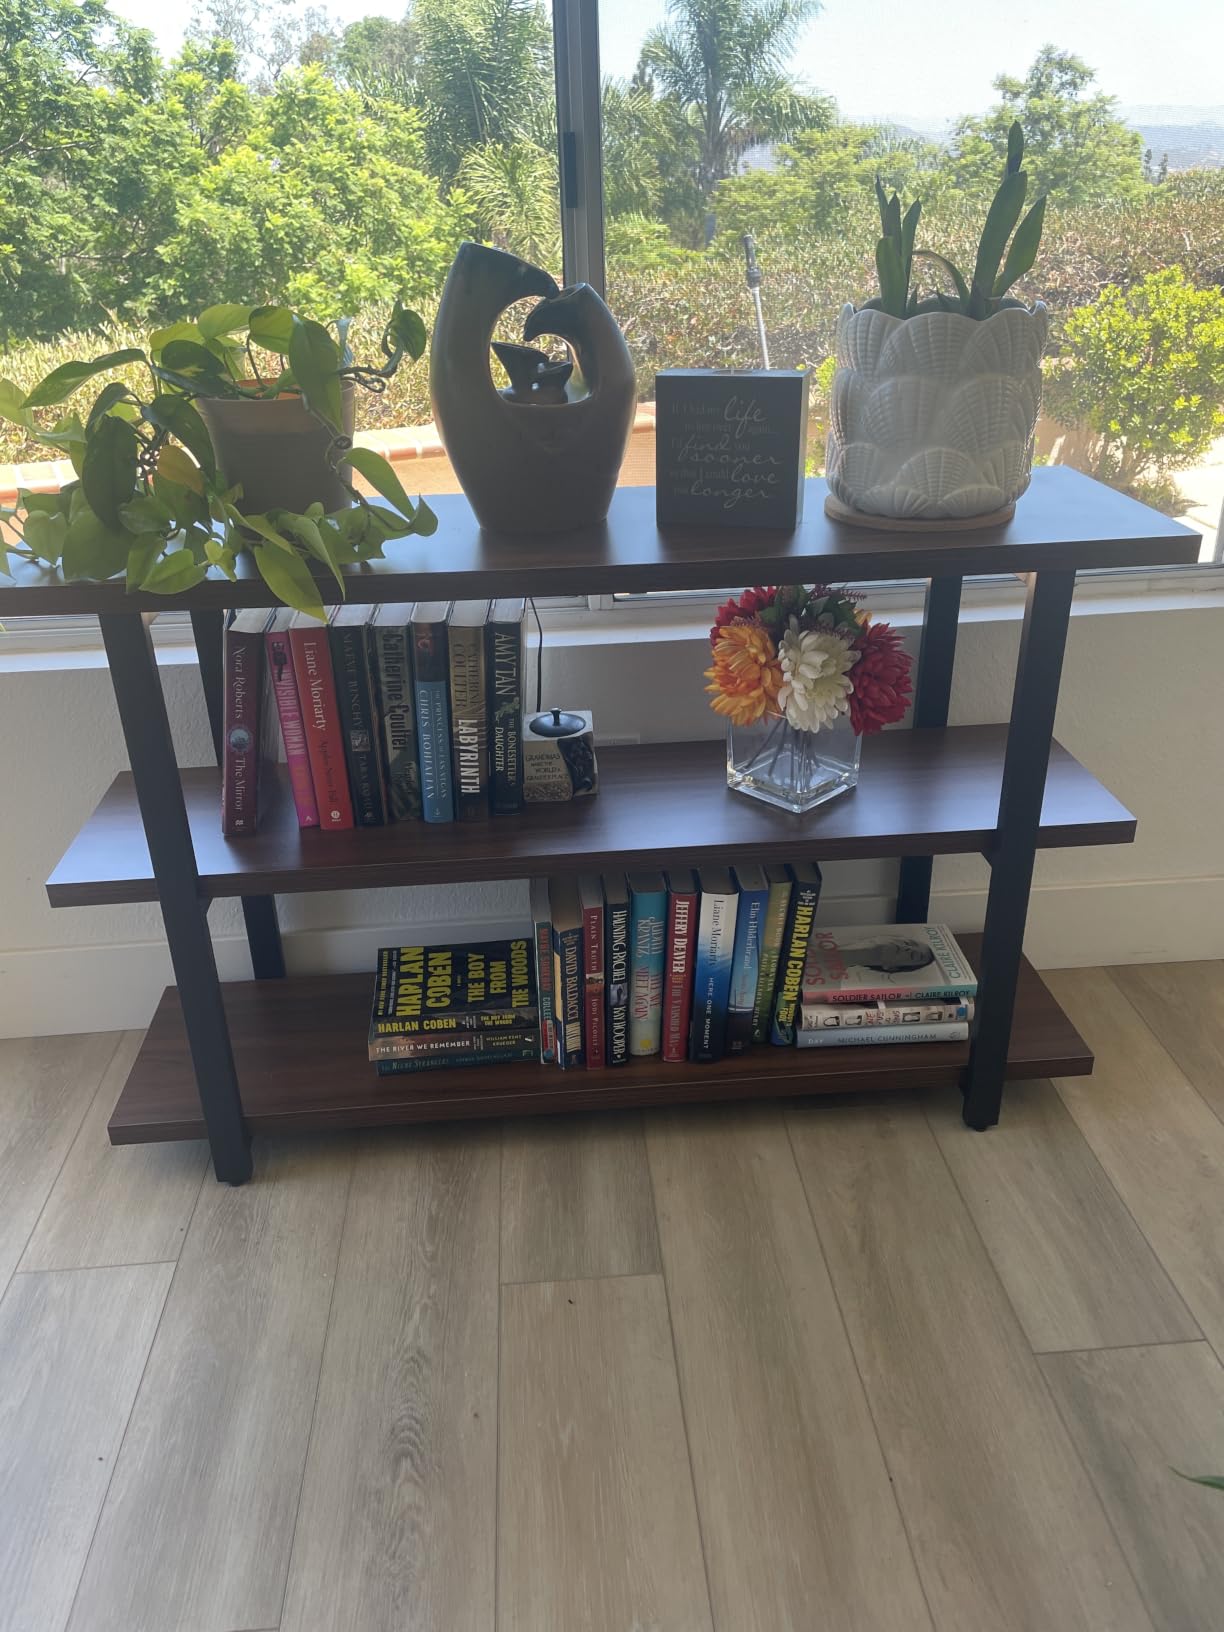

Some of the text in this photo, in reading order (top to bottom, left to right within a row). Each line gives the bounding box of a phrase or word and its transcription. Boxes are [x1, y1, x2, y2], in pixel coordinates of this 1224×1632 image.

[723, 393, 768, 440] life
[678, 432, 730, 462] find
[689, 451, 784, 465] sooner
[690, 479, 769, 509] longer
[731, 463, 780, 485] love
[232, 646, 248, 720] Nora Roberts
[303, 641, 327, 731] Liane Moriarty
[383, 633, 405, 701] Catherine
[453, 643, 467, 708] COULTER
[466, 643, 480, 706] CATHERINE
[495, 632, 518, 696] AMY TAN
[348, 680, 363, 730] BINCHY
[390, 703, 410, 751] Coulter
[283, 719, 306, 757] WOMAN
[419, 689, 436, 800] CHRIS BOHJALIAN
[435, 702, 443, 743] PRINCESS
[440, 771, 448, 800] VEGAS
[458, 719, 480, 794] LABYRINTH
[495, 726, 505, 772] DAUGHTER
[233, 756, 247, 811] The Mirror
[674, 899, 690, 936] JEFFERY
[709, 899, 724, 966] Liane Moriarty
[749, 902, 761, 919] Elin
[789, 906, 815, 958] HARLAN
[590, 915, 599, 972] PLAIN TRUTH
[612, 910, 627, 983] HAUNTING RACHEL
[636, 919, 651, 958] KRANTZ
[649, 916, 664, 955] JUDITH
[671, 938, 688, 973] DEAVER
[743, 921, 759, 969] Hilderbrand
[924, 926, 961, 979] CLAIRE KILROY
[395, 946, 425, 1017] HARLAN
[426, 951, 452, 1008] COBEN
[467, 953, 485, 980] BOY
[490, 960, 507, 994] FROM
[511, 940, 529, 1008] THE WOODS
[539, 927, 553, 992] MAYBE SOMEDAY
[565, 946, 578, 976] DAVID
[783, 959, 804, 1002] COBEN
[467, 981, 485, 1003] THE
[566, 976, 579, 1021] BALDACCI
[635, 964, 650, 1021] MEET AGAIN
[705, 999, 713, 1015] ONE
[778, 1006, 789, 1022] FOOL
[832, 990, 969, 1001] SOLDIER SAILOR CLAIRE KILROY
[377, 1021, 419, 1033] HARLAN
[423, 1018, 457, 1031] COBEN
[592, 998, 601, 1049] JODI PICOULT
[613, 1006, 626, 1054] KAY HOOPER
[670, 1000, 681, 1032] VANISHED
[703, 1018, 711, 1049] MOMENT
[752, 1006, 760, 1027] HENRY
[838, 1036, 874, 1044] MICHAEL
[877, 1033, 937, 1042] CUNNINGHAM
[375, 1046, 391, 1055] THE
[393, 1044, 414, 1053] RIVER
[417, 1042, 429, 1050] WE
[430, 1040, 470, 1049] REMEMBER
